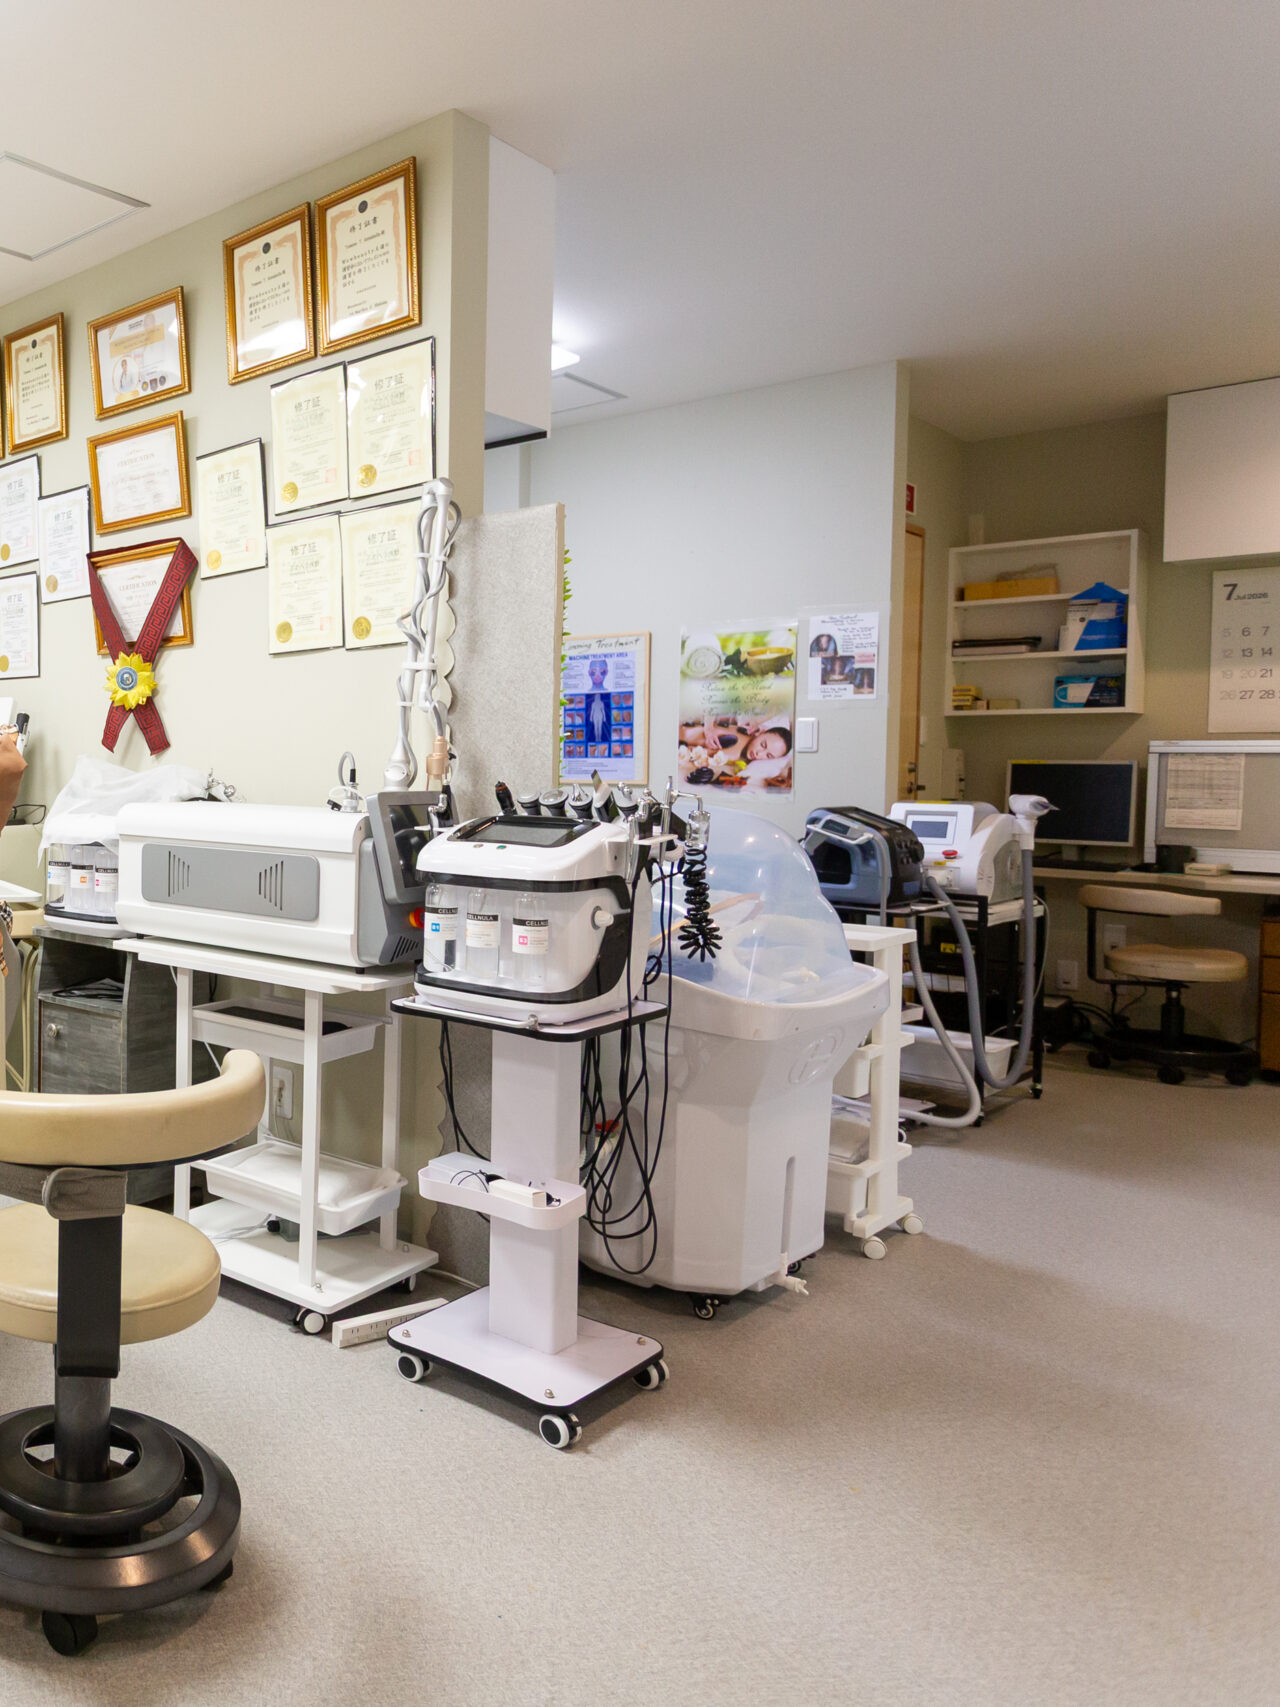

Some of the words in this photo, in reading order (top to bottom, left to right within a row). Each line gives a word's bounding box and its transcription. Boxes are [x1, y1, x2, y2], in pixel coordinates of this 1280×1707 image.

[373, 373, 405, 391] 修了証
[294, 396, 321, 413] 修了証
[367, 529, 397, 545] 修了証
[290, 542, 318, 557] 修了証
[1223, 583, 1238, 600] 7
[1223, 628, 1232, 638] 5
[1241, 627, 1251, 637] 6
[1262, 626, 1270, 636] 7
[1223, 649, 1233, 658] 12
[1241, 648, 1253, 658] 13
[1261, 648, 1272, 658] 14
[1222, 669, 1233, 679] 19
[1241, 669, 1257, 679] 20
[1260, 668, 1273, 678] 21
[1240, 690, 1255, 700] 27
[1259, 690, 1276, 700] 28
